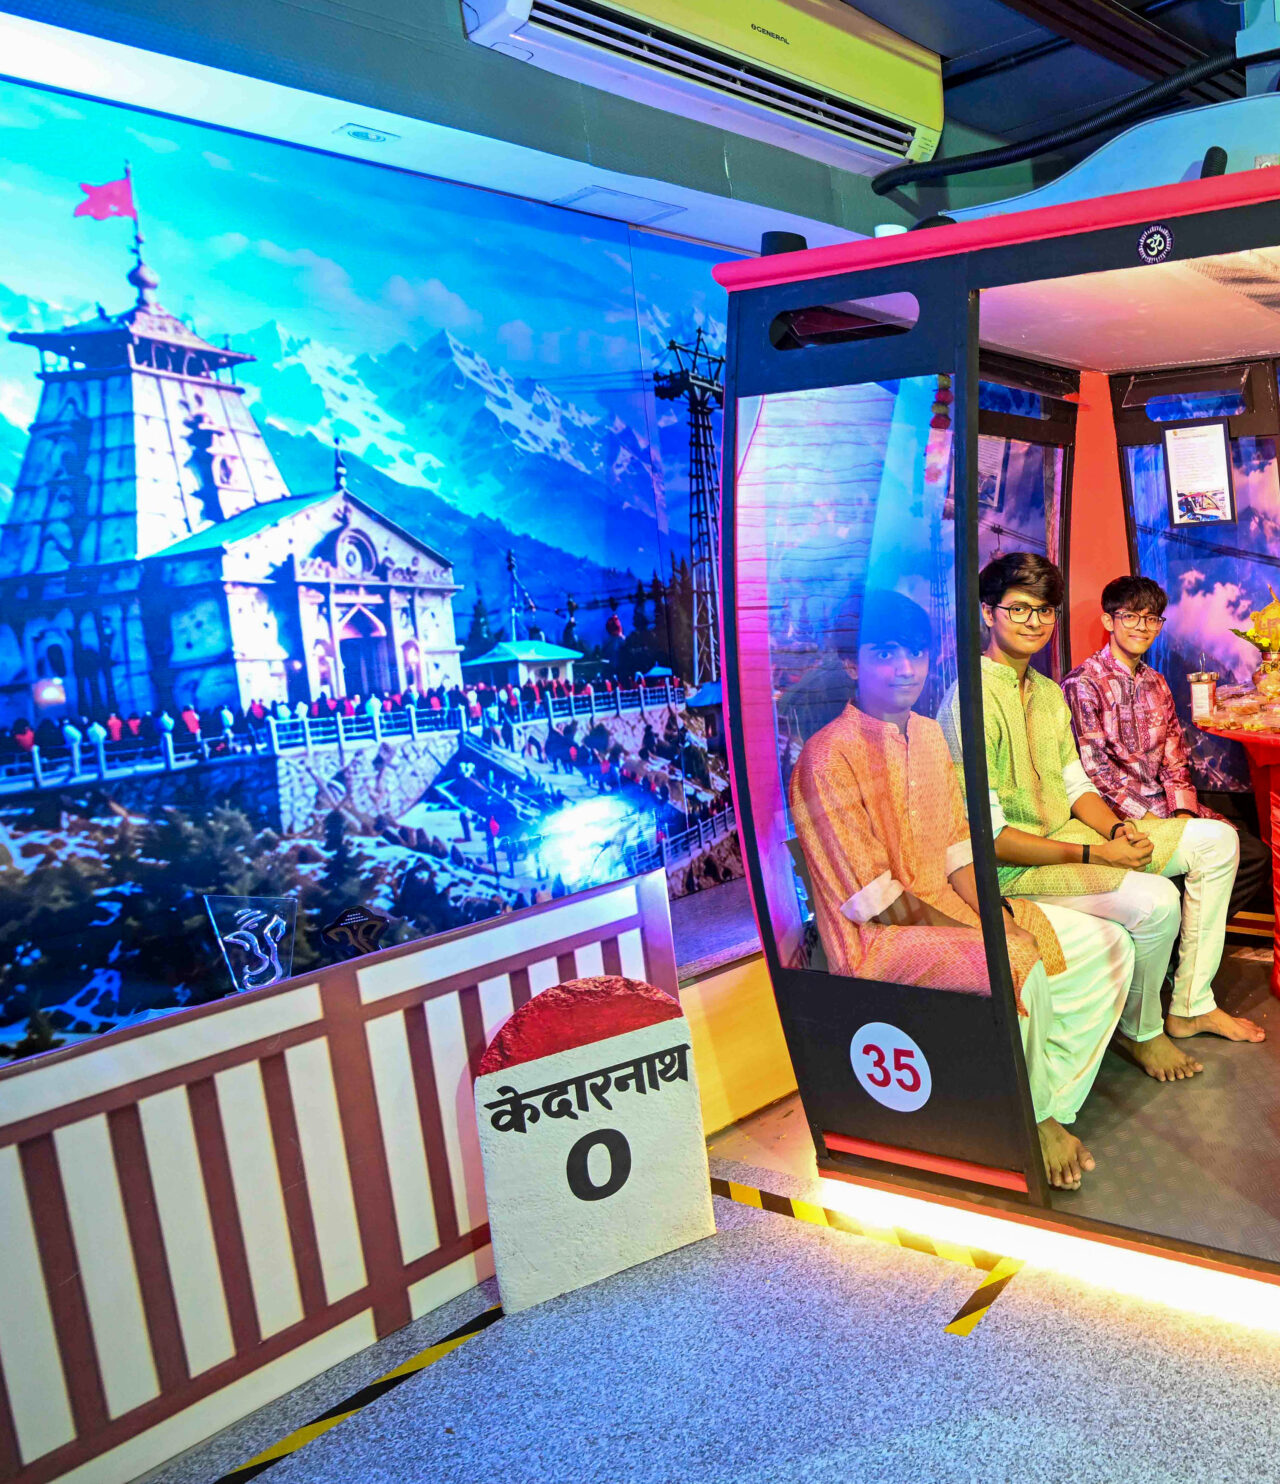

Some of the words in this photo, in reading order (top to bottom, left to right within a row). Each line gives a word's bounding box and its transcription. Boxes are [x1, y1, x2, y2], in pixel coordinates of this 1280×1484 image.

[483, 1043, 691, 1134] केदारनाथ
[862, 1043, 922, 1093] 35
[566, 1128, 632, 1202] 0
